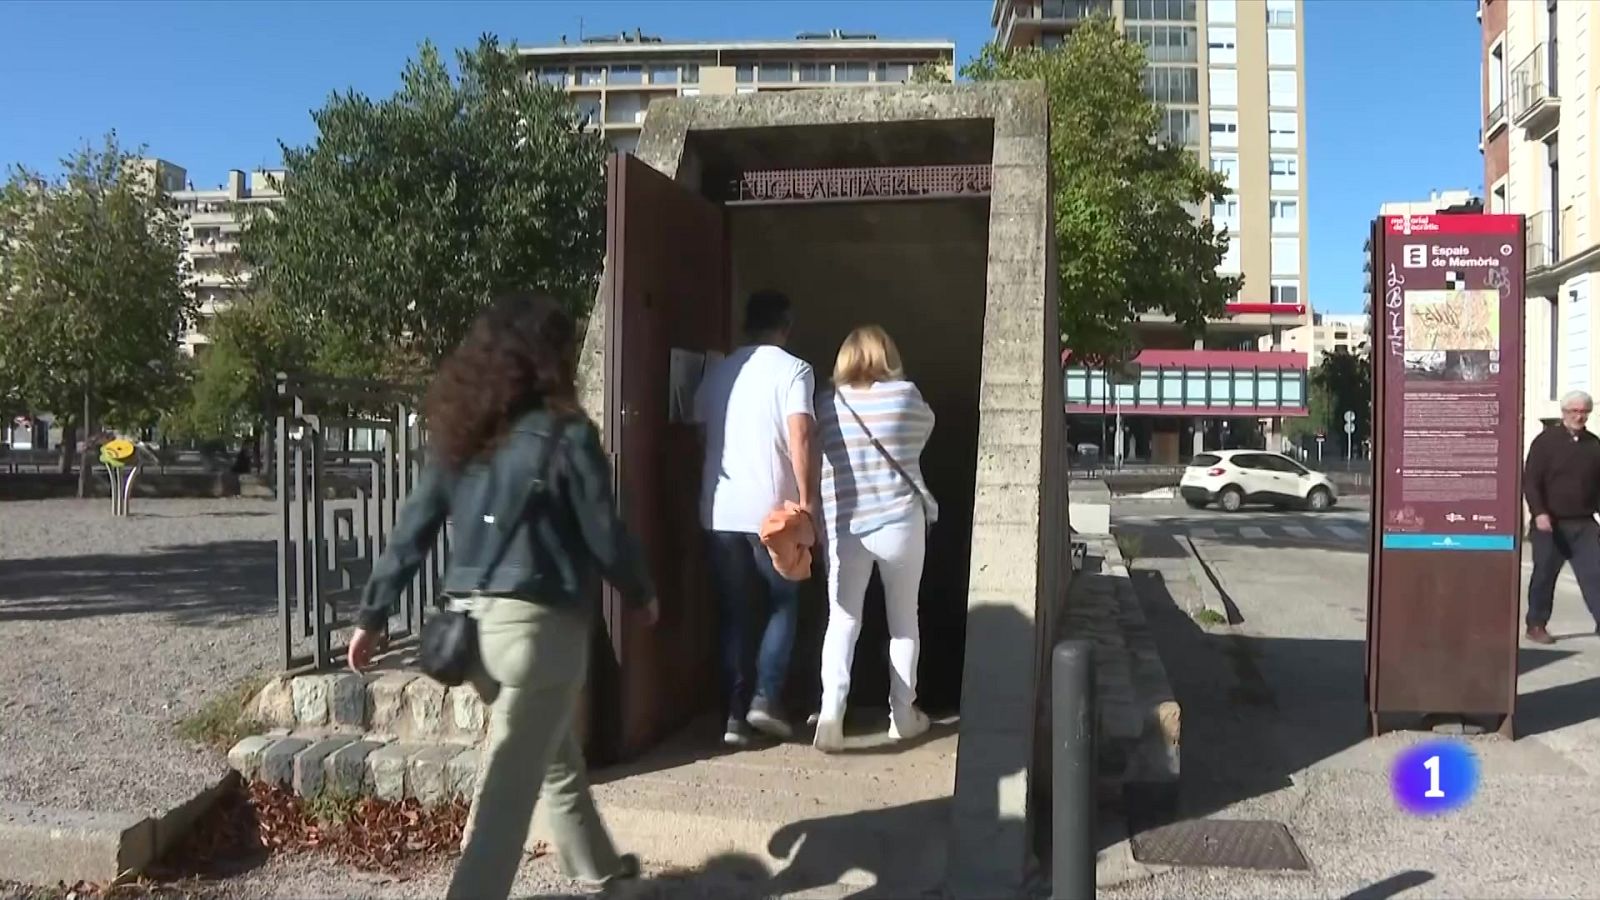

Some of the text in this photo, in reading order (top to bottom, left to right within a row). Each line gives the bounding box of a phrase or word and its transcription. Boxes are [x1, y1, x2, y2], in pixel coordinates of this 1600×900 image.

[1390, 216, 1429, 224] meorial
[1410, 248, 1421, 265] E
[1431, 245, 1470, 257] Espais
[1431, 256, 1500, 267] de Memòria
